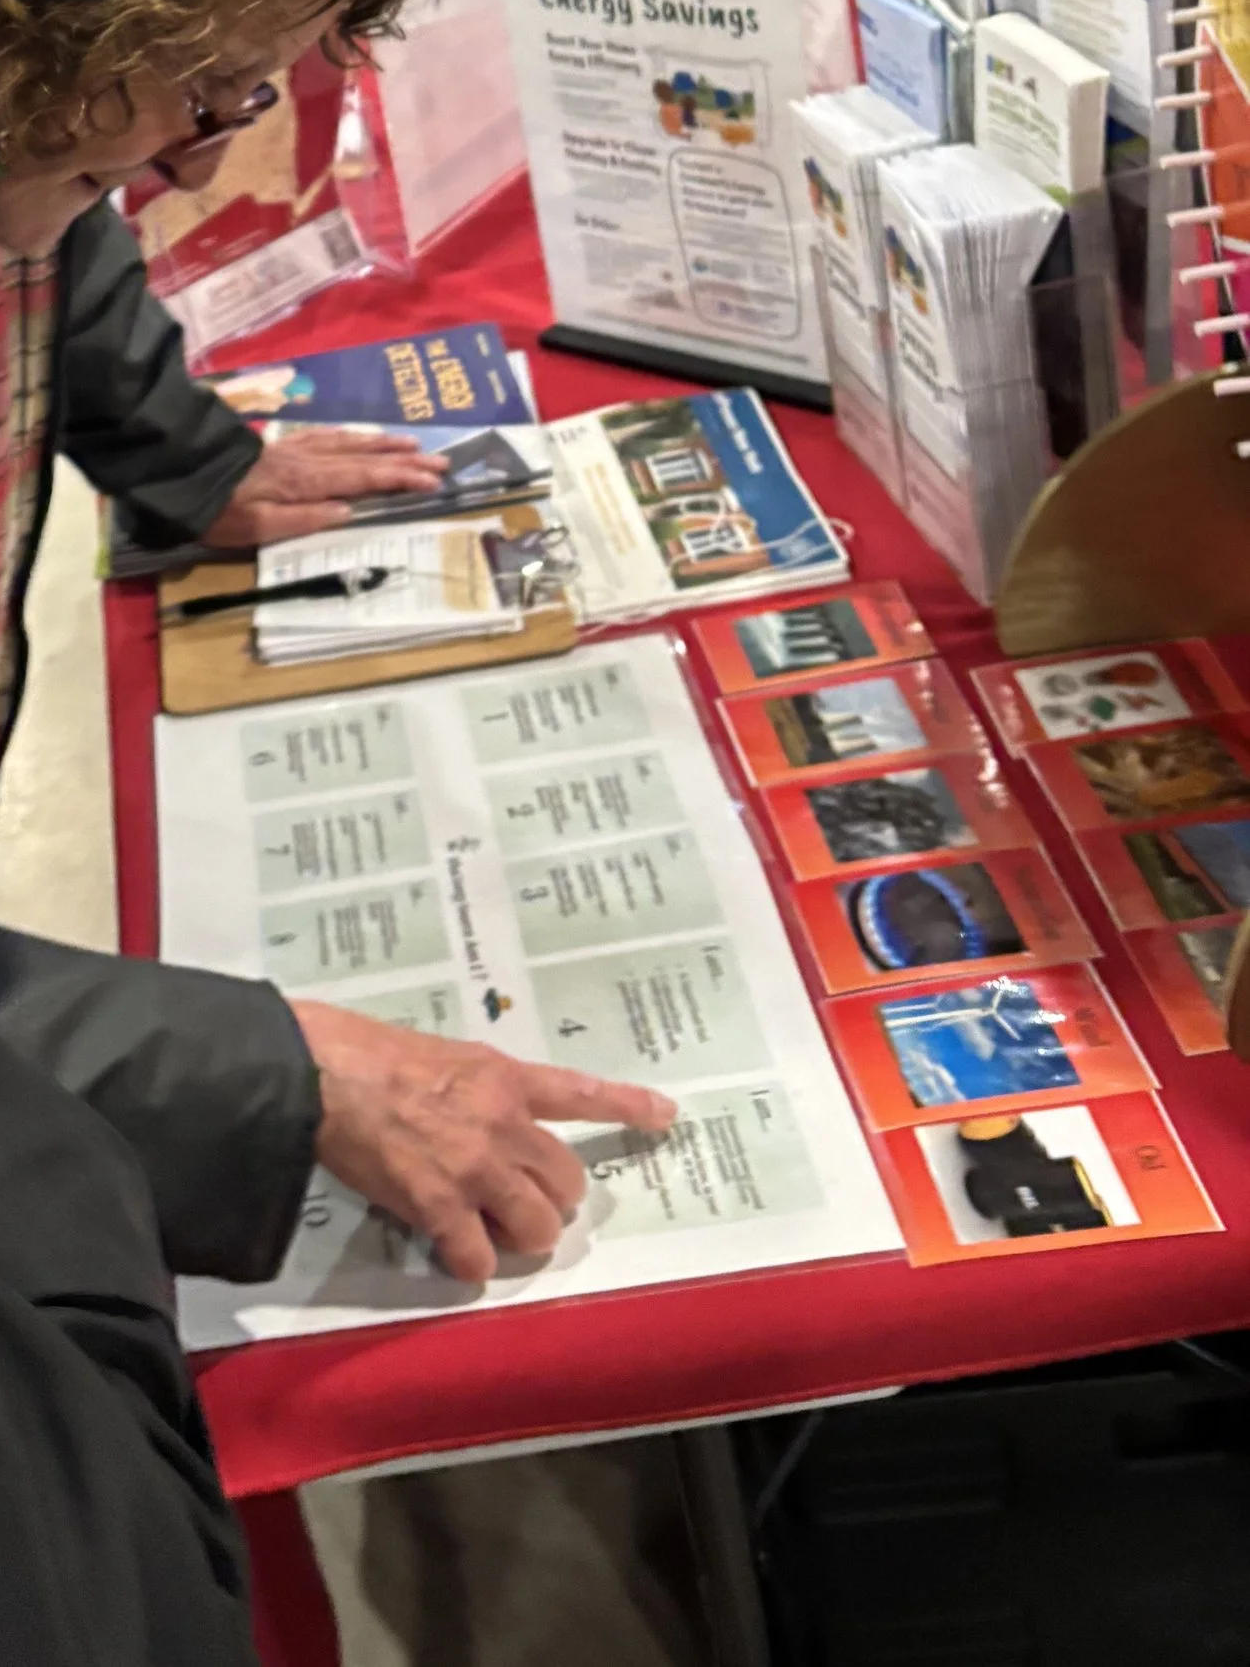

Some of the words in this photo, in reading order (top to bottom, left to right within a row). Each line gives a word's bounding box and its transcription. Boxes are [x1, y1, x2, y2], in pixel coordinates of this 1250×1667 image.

[383, 342, 435, 422] DETECTIVES
[558, 1017, 588, 1037] 4
[591, 1165, 622, 1180] 5
